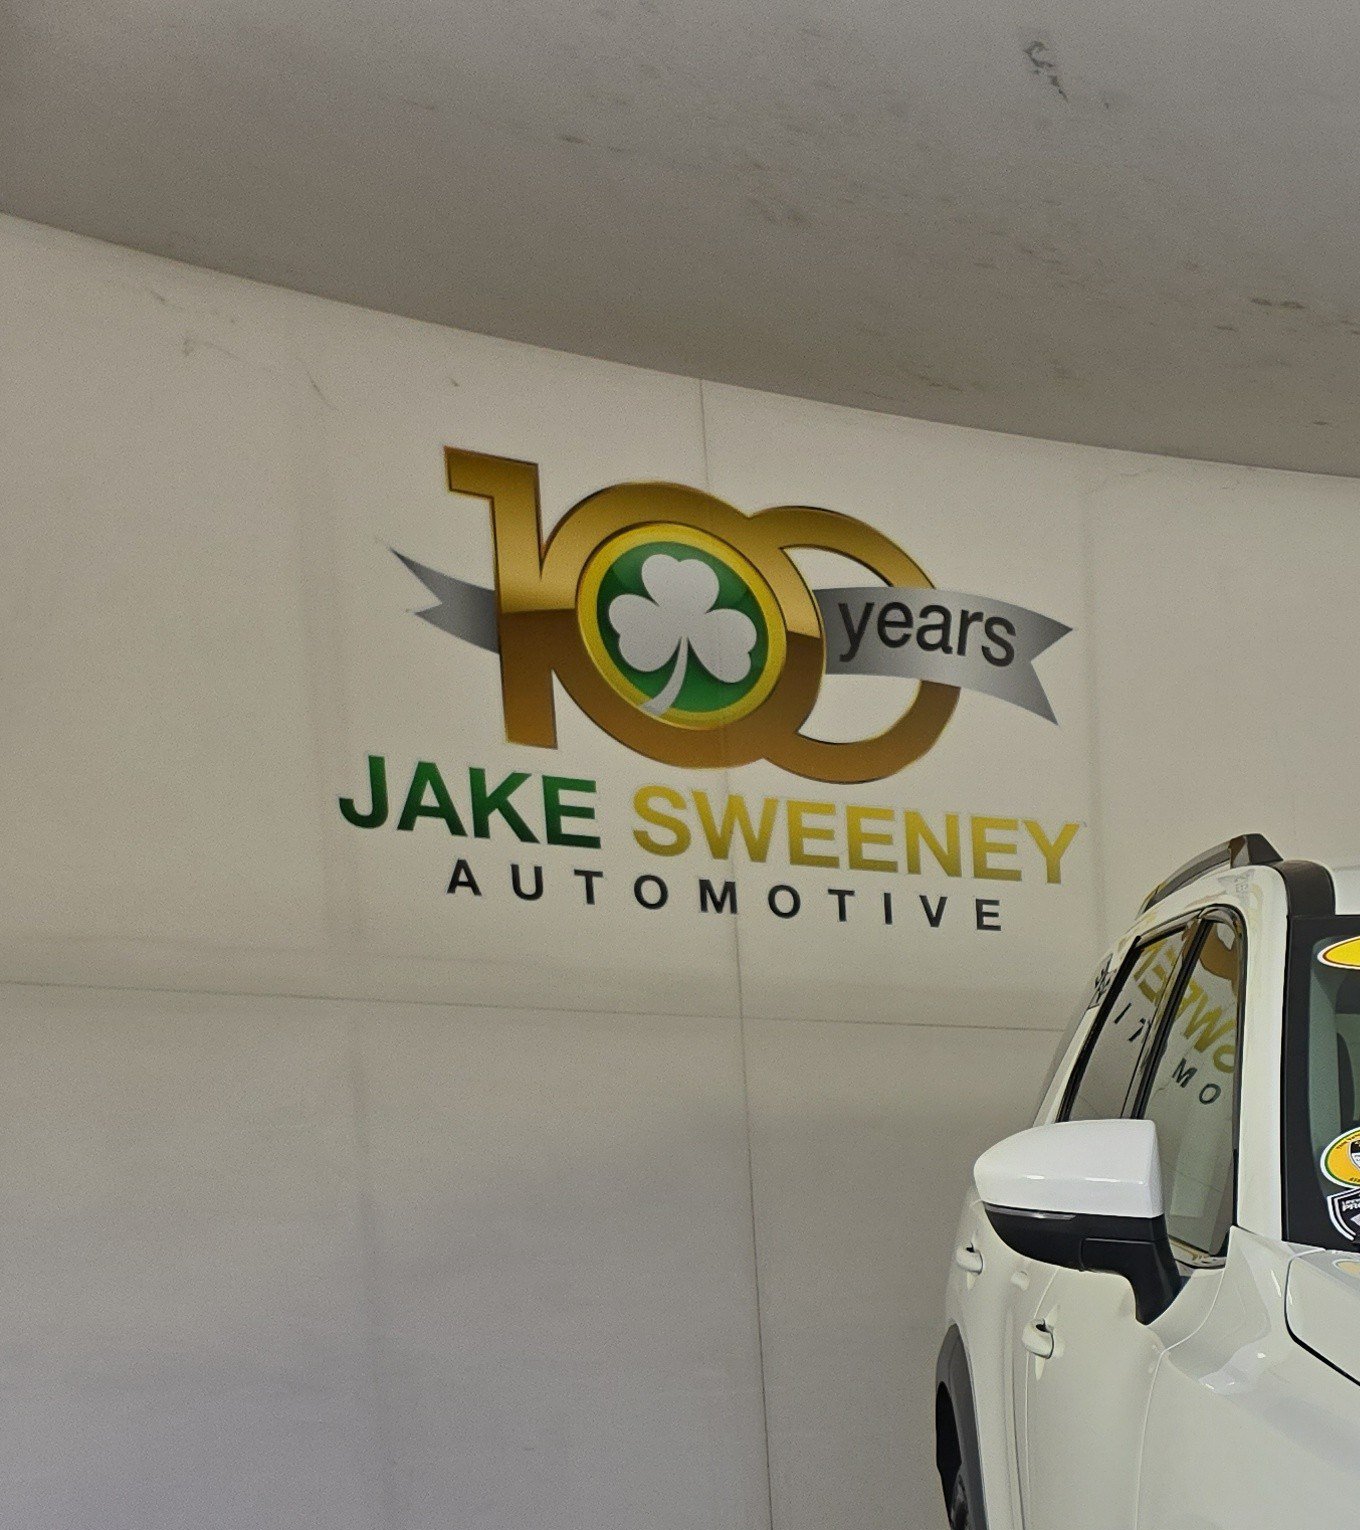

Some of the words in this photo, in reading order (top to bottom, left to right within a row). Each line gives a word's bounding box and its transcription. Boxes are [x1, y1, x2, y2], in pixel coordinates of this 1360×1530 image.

[444, 446, 961, 784] 100
[838, 599, 1017, 668] years
[338, 755, 602, 850] JAKE
[632, 785, 1081, 886] SWEENEY
[446, 858, 1003, 932] AUTOMOTIVE
